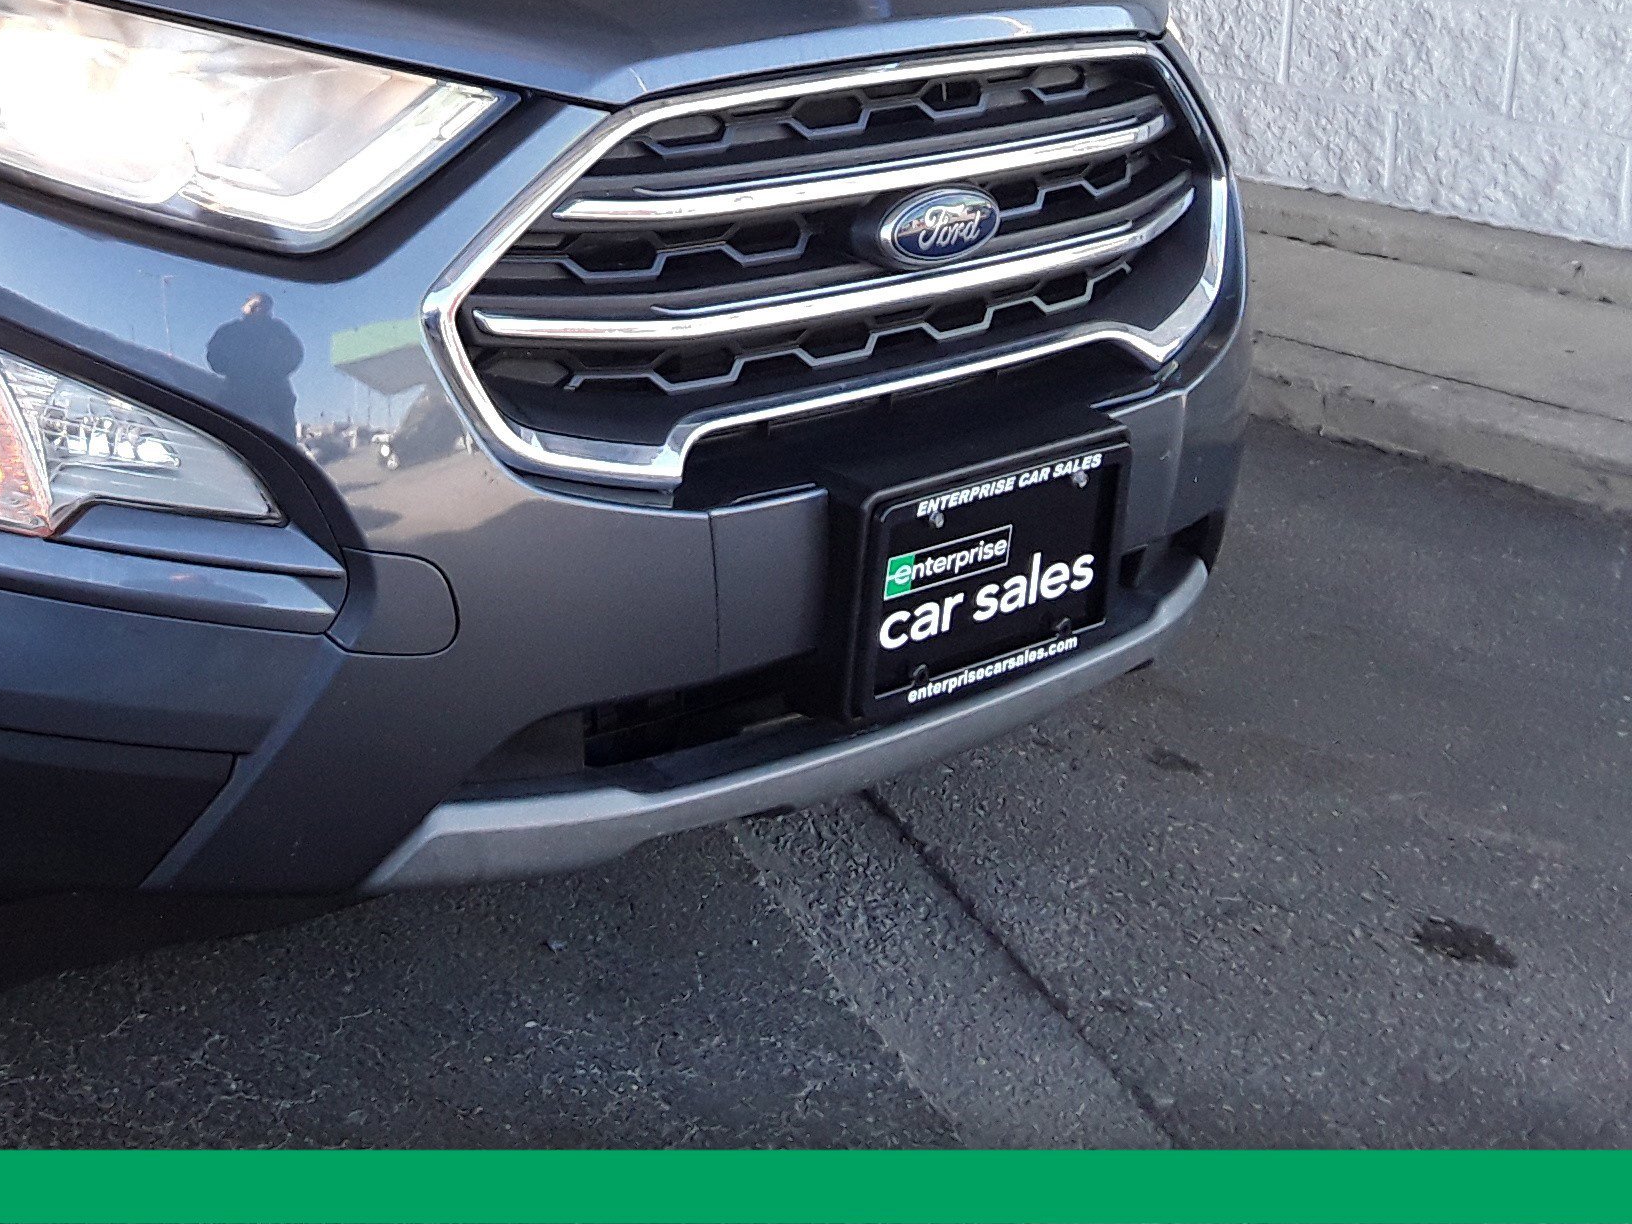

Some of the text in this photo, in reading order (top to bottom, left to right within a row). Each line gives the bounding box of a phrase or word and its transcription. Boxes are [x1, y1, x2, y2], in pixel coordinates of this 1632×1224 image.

[919, 205, 981, 250] Ford
[916, 453, 1102, 517] ENTERPRISE CAR SALES
[889, 536, 1008, 586] enterprise
[880, 552, 1096, 650] car sales
[908, 637, 1078, 703] enterprisecarsales.com
